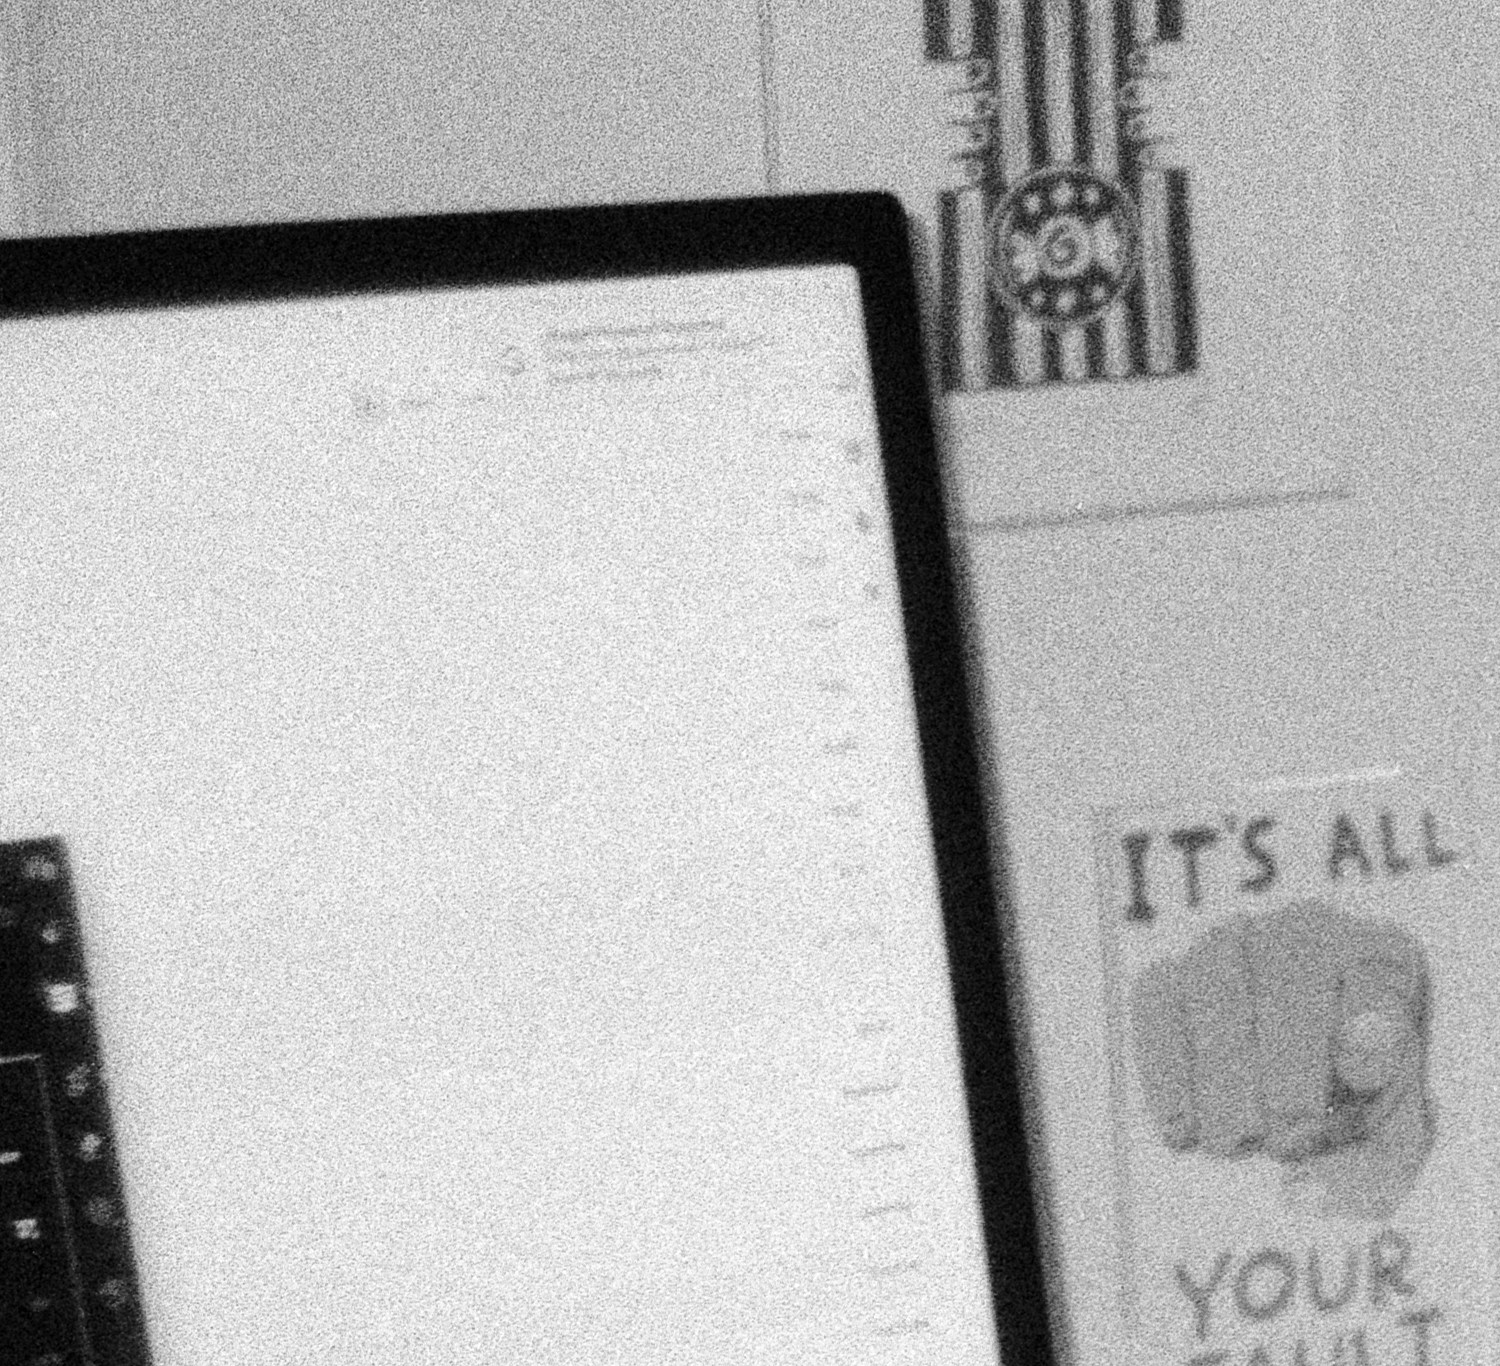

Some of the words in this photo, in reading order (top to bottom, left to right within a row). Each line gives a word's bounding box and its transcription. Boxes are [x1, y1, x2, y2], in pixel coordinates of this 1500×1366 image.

[1121, 812, 1277, 923] IT'S
[1328, 810, 1459, 880] ALL
[1174, 1229, 1417, 1342] YOUR
